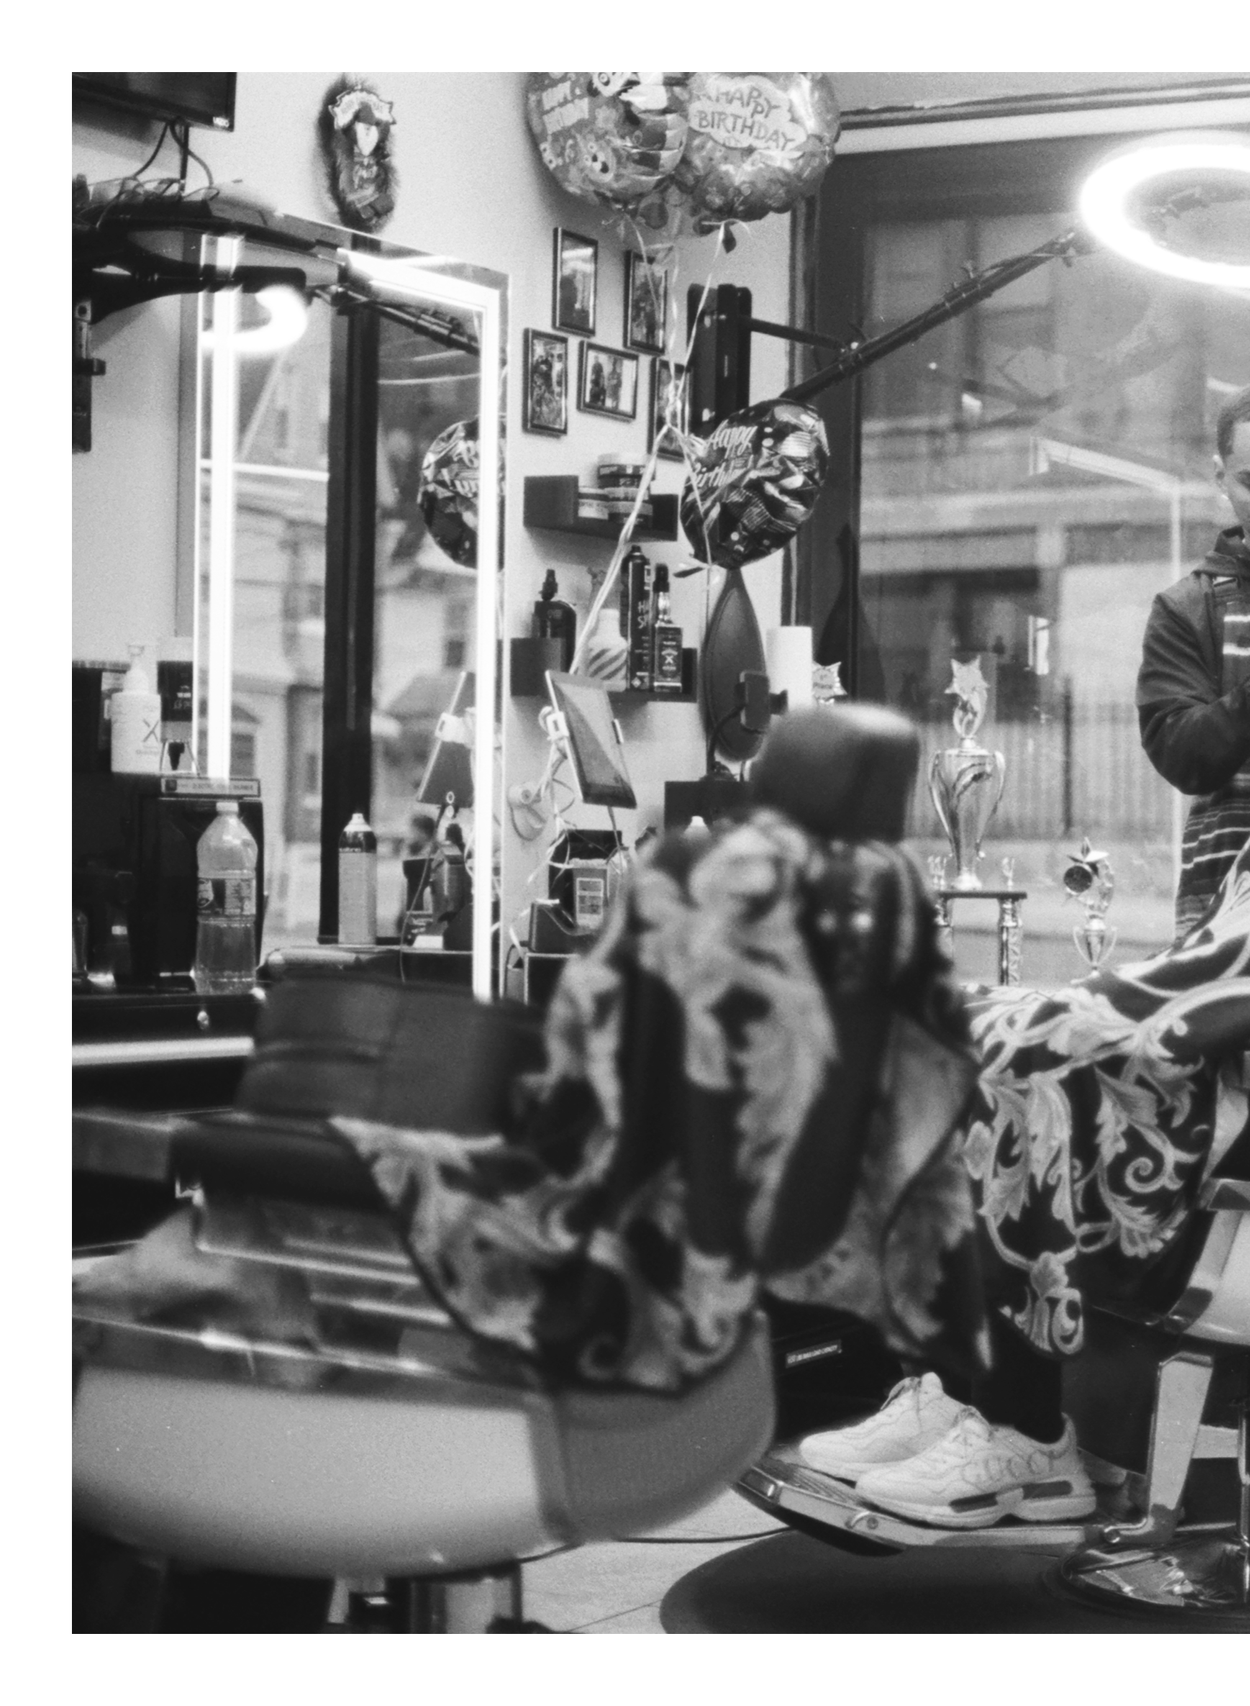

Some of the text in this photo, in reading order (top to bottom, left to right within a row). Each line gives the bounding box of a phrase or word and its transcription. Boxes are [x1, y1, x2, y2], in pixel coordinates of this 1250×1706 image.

[714, 85, 781, 119] HAPPY
[694, 109, 796, 151] BIRTHDAY
[706, 418, 759, 457] Happy
